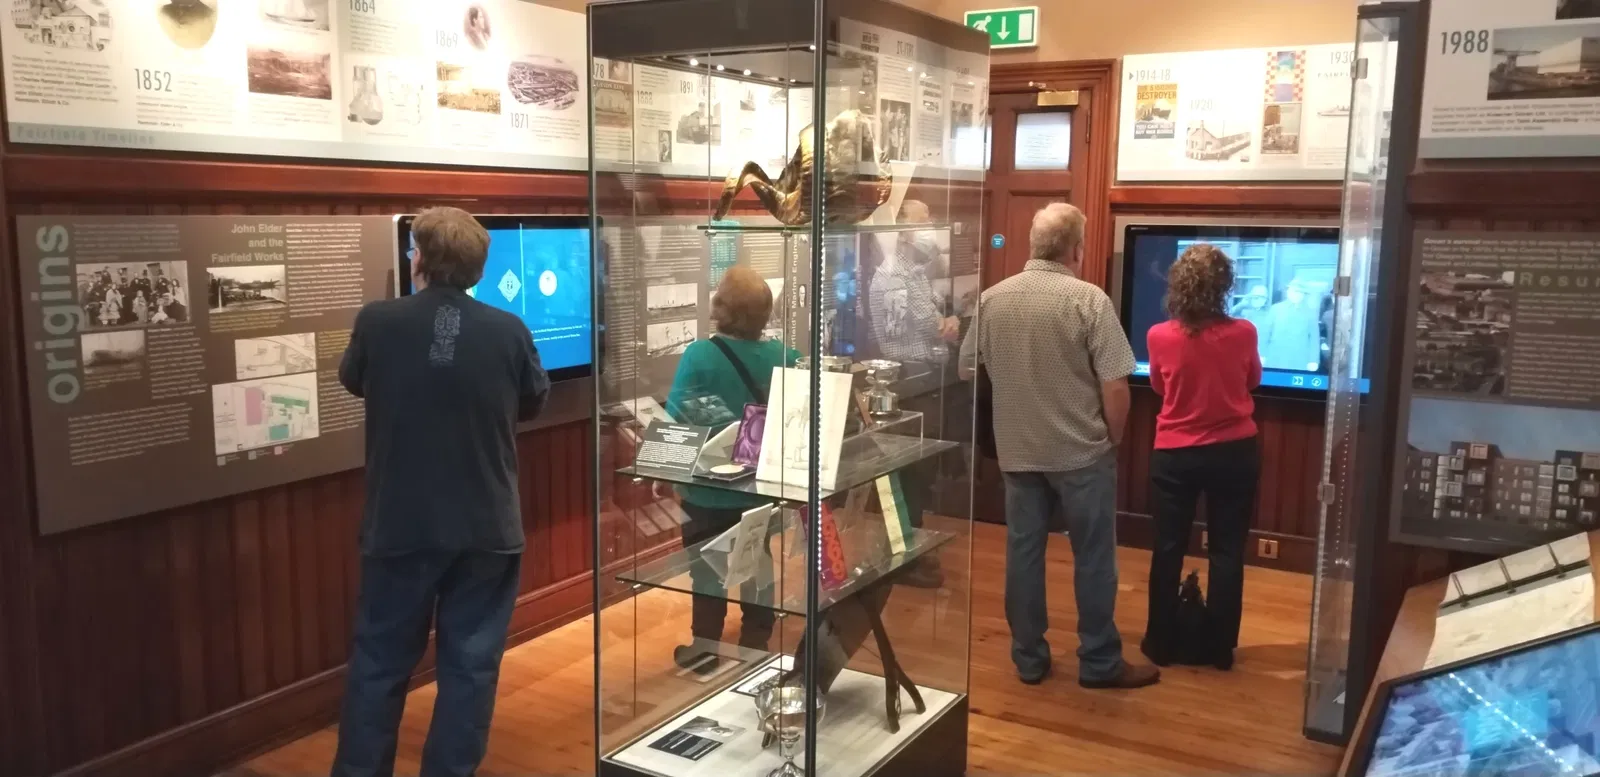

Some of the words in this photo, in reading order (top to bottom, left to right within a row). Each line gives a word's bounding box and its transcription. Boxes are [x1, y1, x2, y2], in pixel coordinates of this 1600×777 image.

[349, 0, 376, 14] 1864
[435, 30, 458, 48] 1869
[1441, 30, 1489, 54] 1988
[595, 63, 605, 79] 78
[1136, 68, 1171, 81] 1914-18
[134, 68, 173, 92] 1852
[1137, 91, 1177, 100] DESTROYER
[510, 112, 529, 128] 1871
[231, 224, 256, 234] John
[258, 223, 283, 233] Elder
[248, 238, 266, 247] and
[268, 237, 284, 247] the
[211, 253, 252, 263] Fairfield
[254, 252, 285, 262] Works
[31, 225, 85, 404] origins
